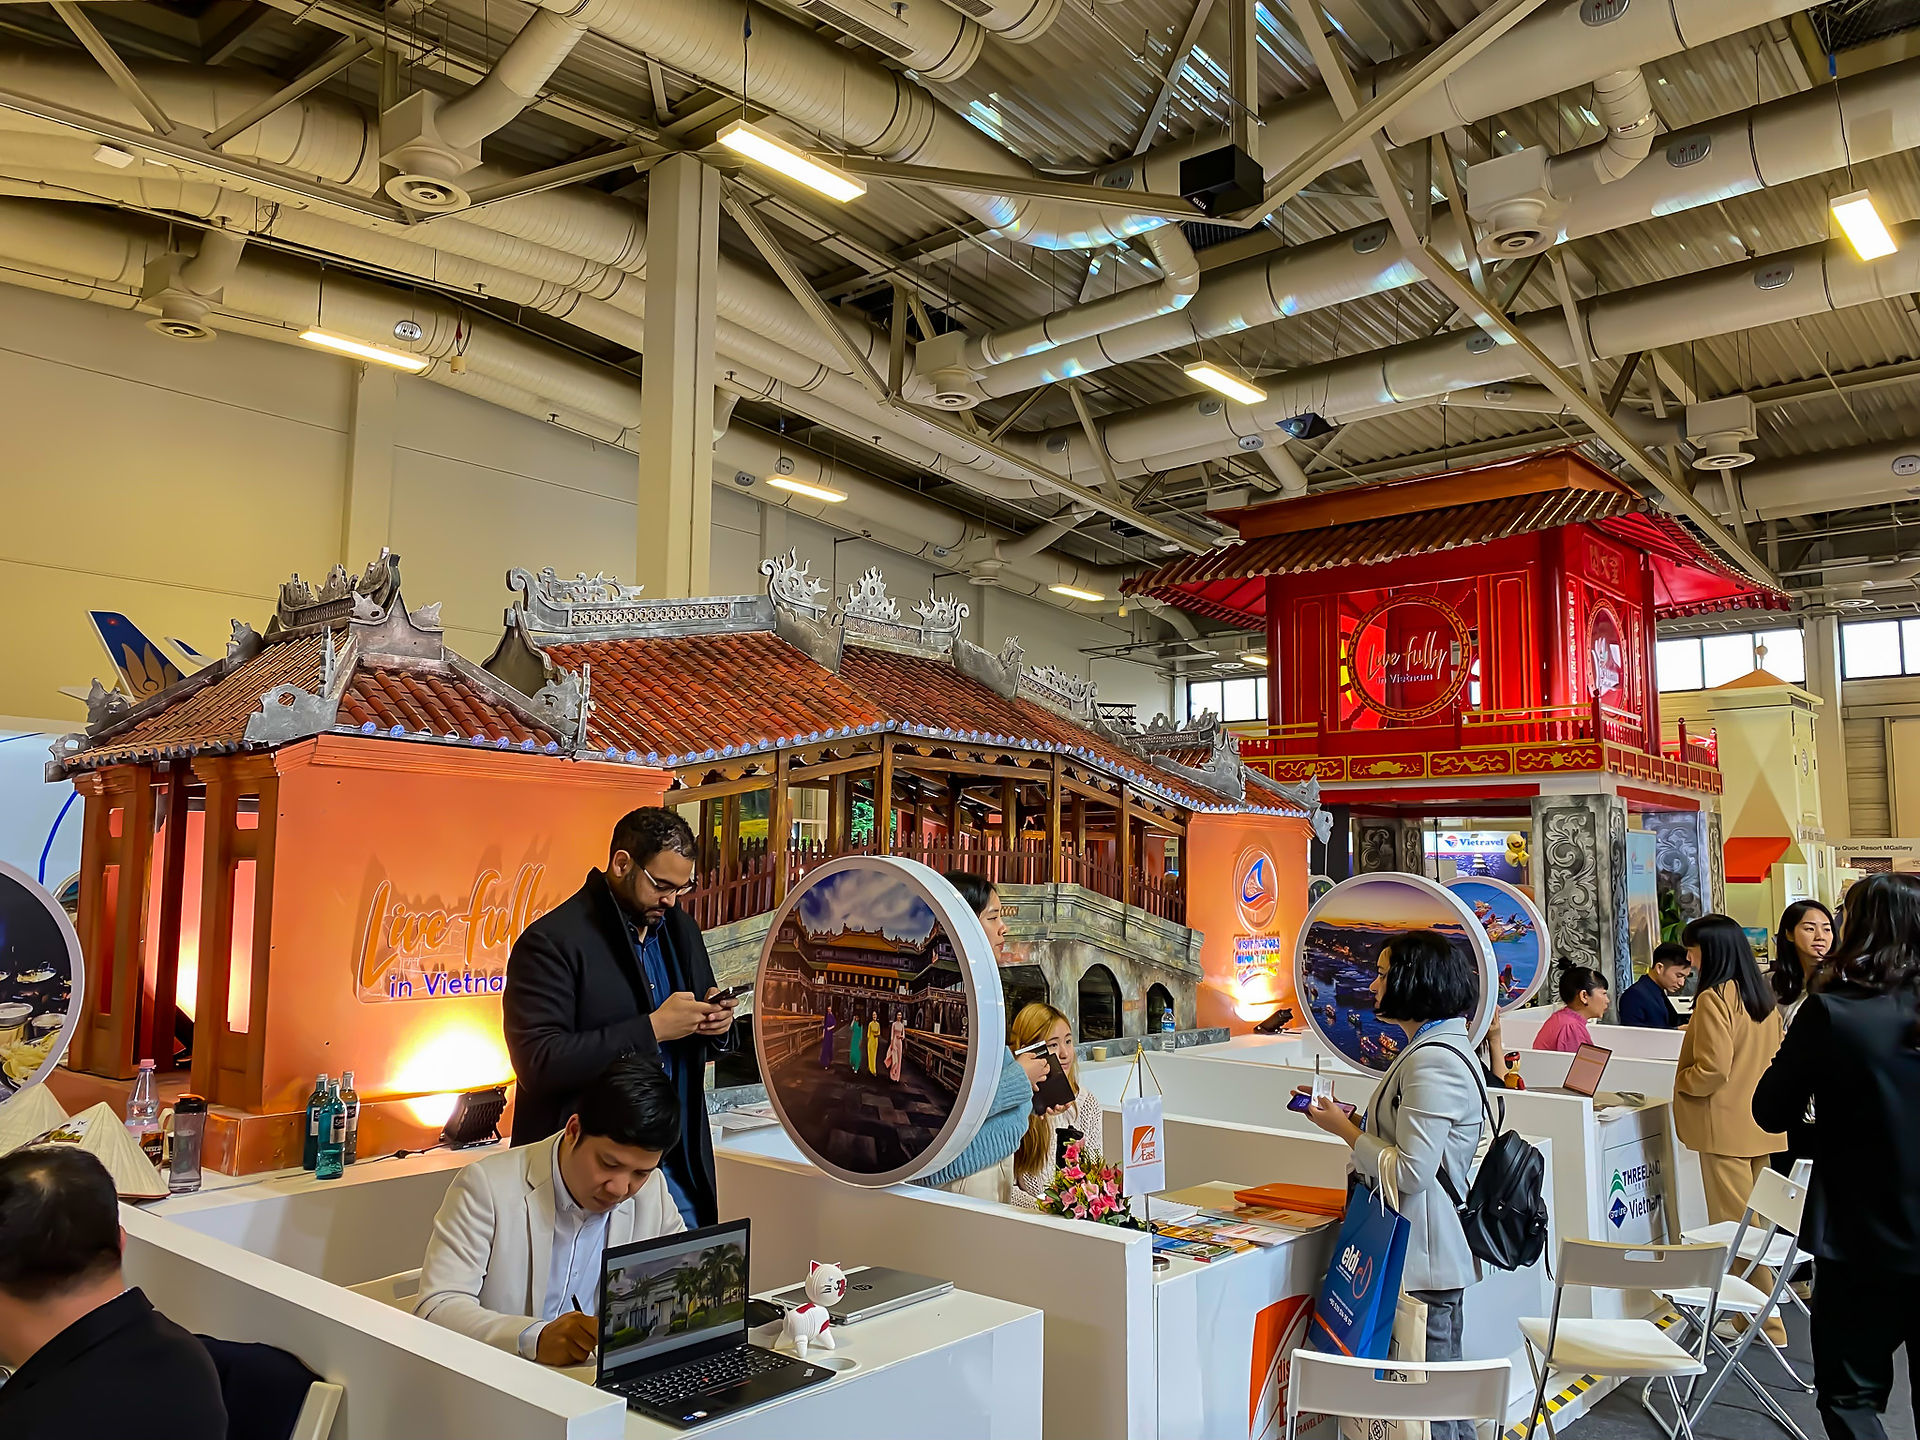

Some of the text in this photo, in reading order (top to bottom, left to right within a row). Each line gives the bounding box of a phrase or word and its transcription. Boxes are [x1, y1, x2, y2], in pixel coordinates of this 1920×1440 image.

[1367, 631, 1447, 681] Live fully
[1390, 674, 1433, 684] Vietnam
[1459, 838, 1504, 847] Vietravel
[1884, 844, 1912, 852] MGallery
[361, 863, 548, 990] Live full
[389, 972, 505, 998] in Vietna
[1142, 1148, 1155, 1161] East
[1629, 1194, 1661, 1219] Vietnam
